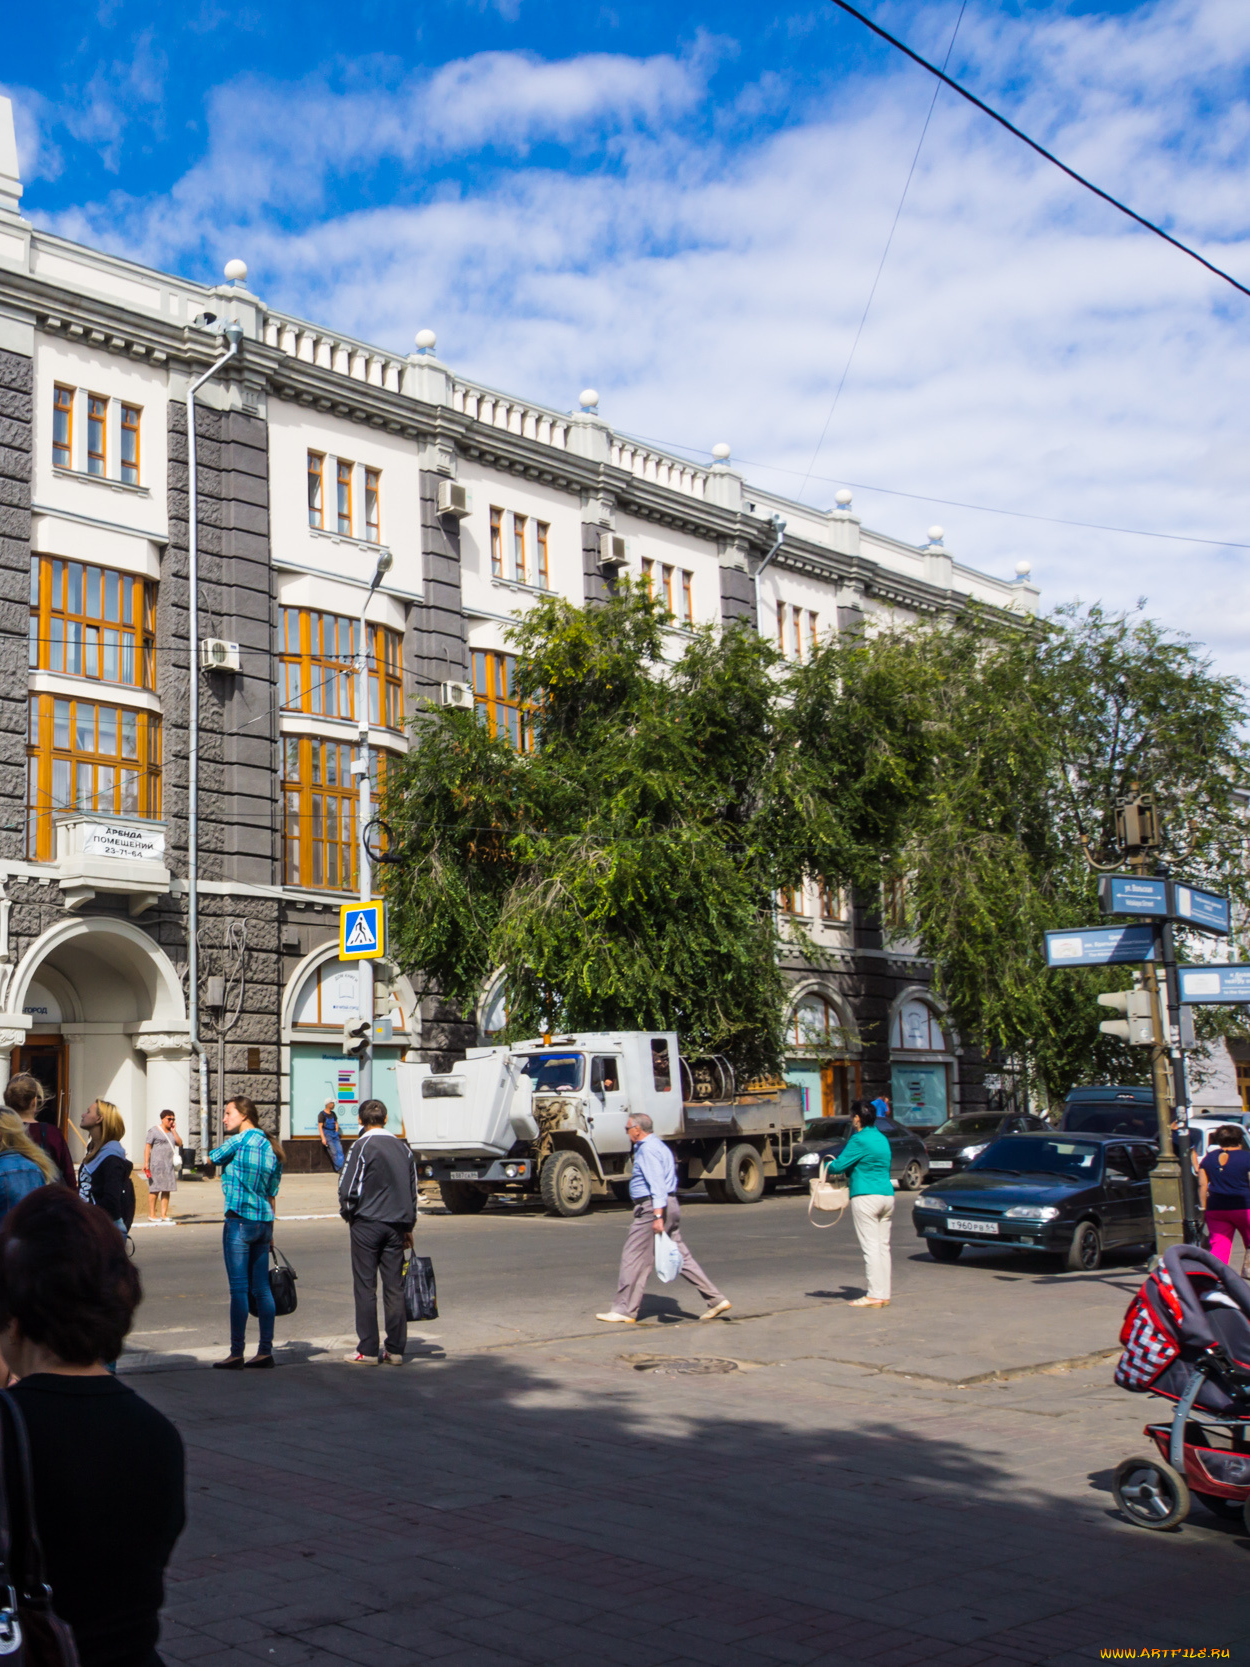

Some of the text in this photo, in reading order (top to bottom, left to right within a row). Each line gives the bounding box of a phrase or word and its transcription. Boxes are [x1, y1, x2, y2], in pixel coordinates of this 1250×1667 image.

[106, 827, 142, 839] АРЕНДА
[93, 835, 154, 850] ПОМЕЩЕНИЙ
[105, 846, 143, 858] 23-71-64
